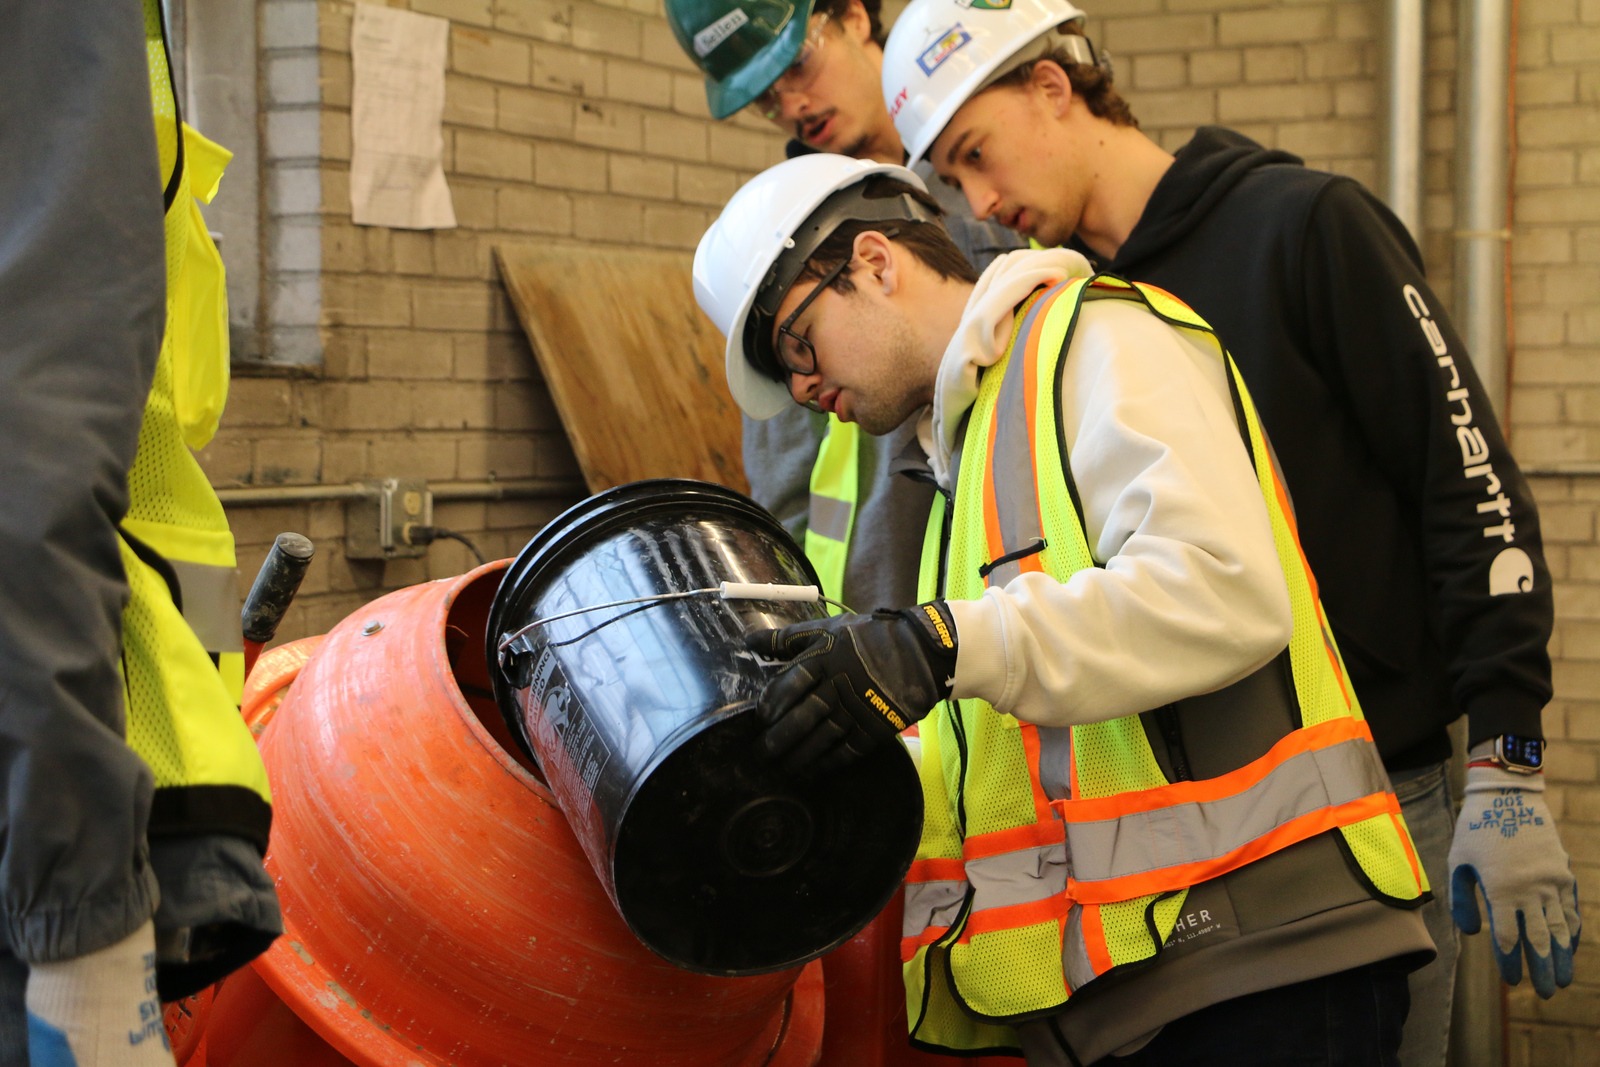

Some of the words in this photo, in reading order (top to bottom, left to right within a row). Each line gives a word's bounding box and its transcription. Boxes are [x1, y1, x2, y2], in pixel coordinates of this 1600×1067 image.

[923, 604, 943, 625] FIRM
[935, 622, 954, 649] GRIP
[529, 651, 550, 712] WARNING
[532, 679, 546, 719] AVISO
[865, 688, 890, 715] FIRM
[1482, 807, 1535, 820] ATLAS
[1493, 795, 1524, 808] 300
[1173, 909, 1212, 932] HER
